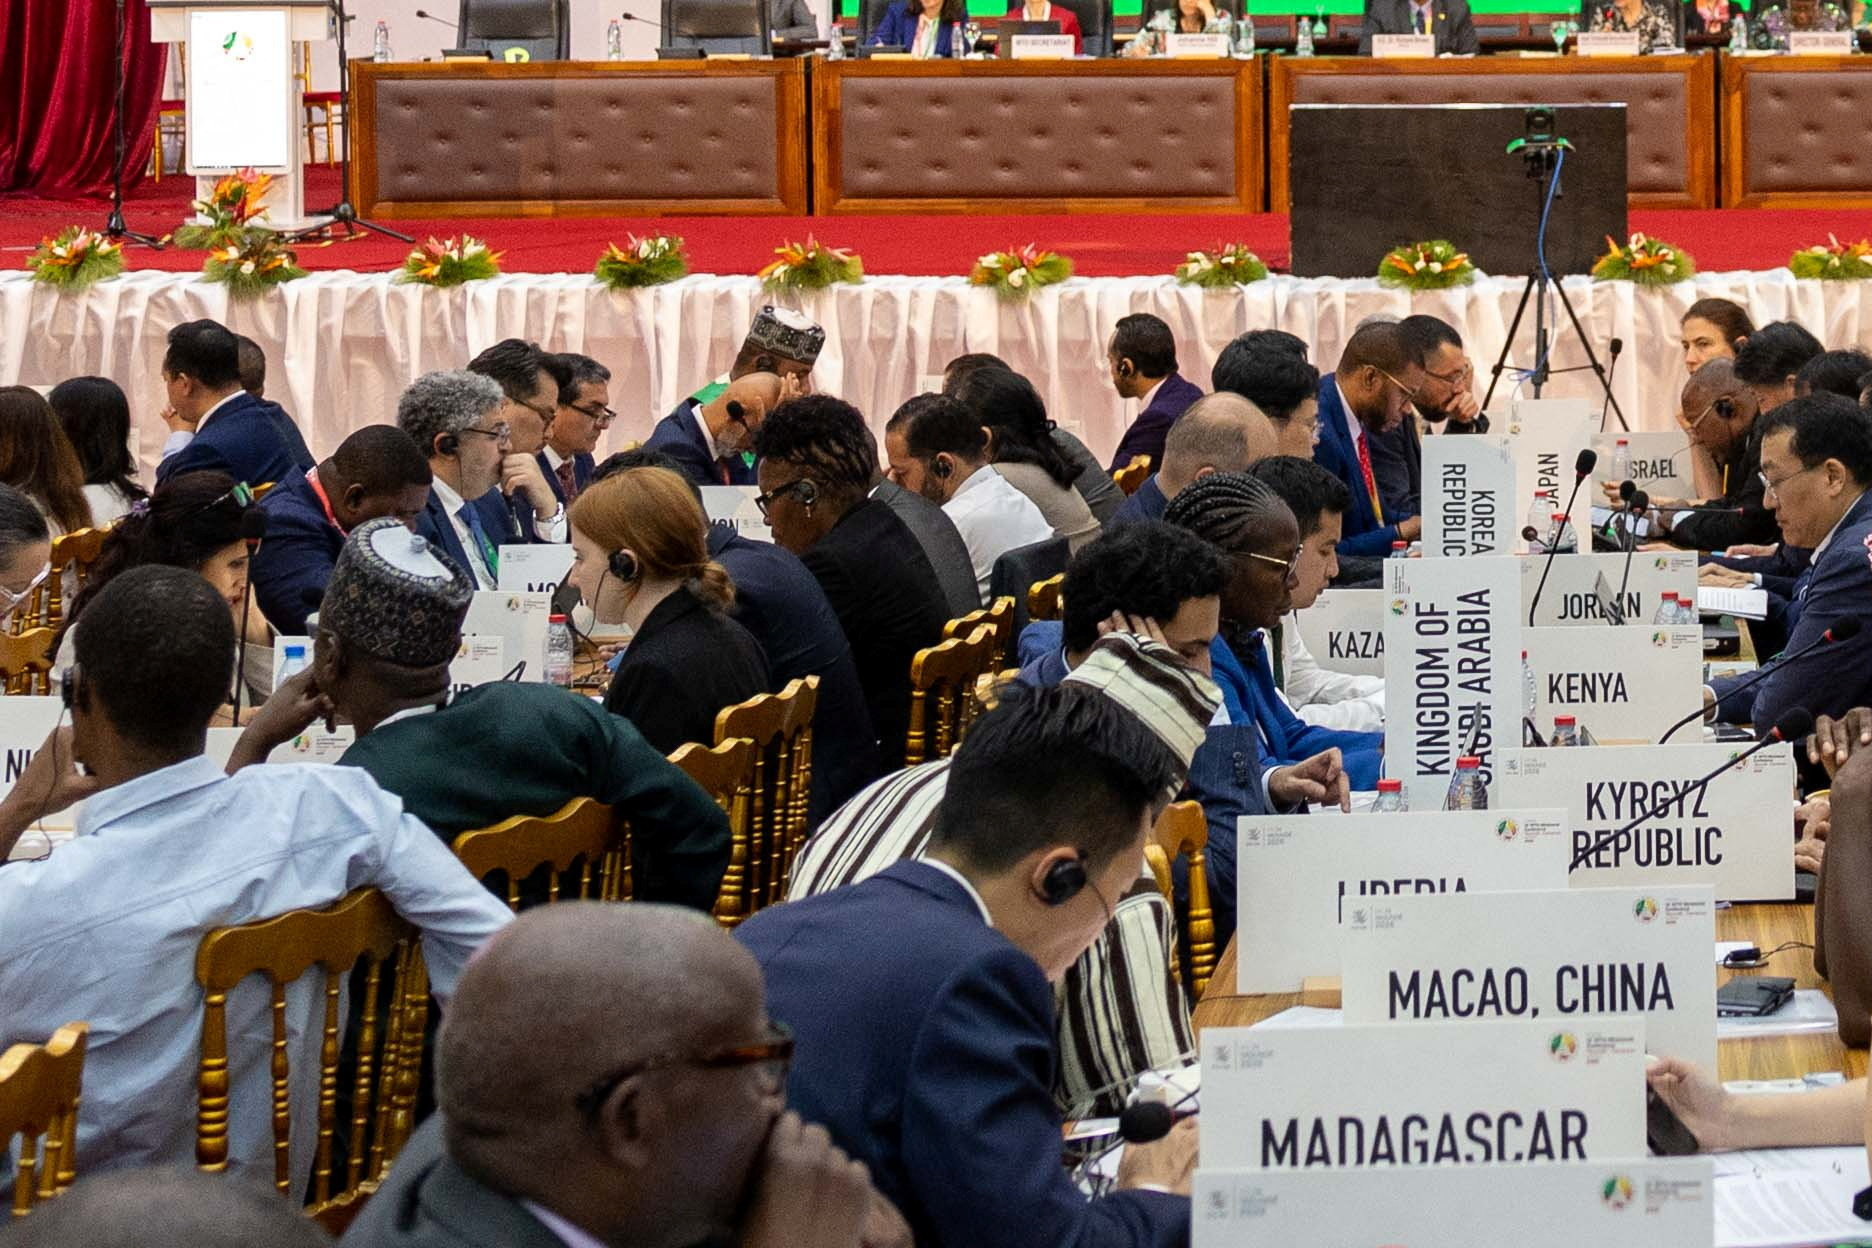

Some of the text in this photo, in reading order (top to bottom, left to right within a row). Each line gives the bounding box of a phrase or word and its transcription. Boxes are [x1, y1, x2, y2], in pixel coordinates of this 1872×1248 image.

[1442, 464, 1466, 558] REPUBLIC
[1471, 490, 1495, 555] KOREA
[1328, 631, 1384, 659] KAZA
[1456, 589, 1491, 694] ARABIA
[1415, 602, 1450, 776] KINGDOM OF
[1548, 672, 1629, 704] KENYA
[1586, 779, 1710, 821] KYRGYZ
[1572, 826, 1723, 869] REPUBLIC
[1389, 962, 1675, 1020] MACAO, CHINA
[1261, 1109, 1589, 1169] MADAGASCAR
